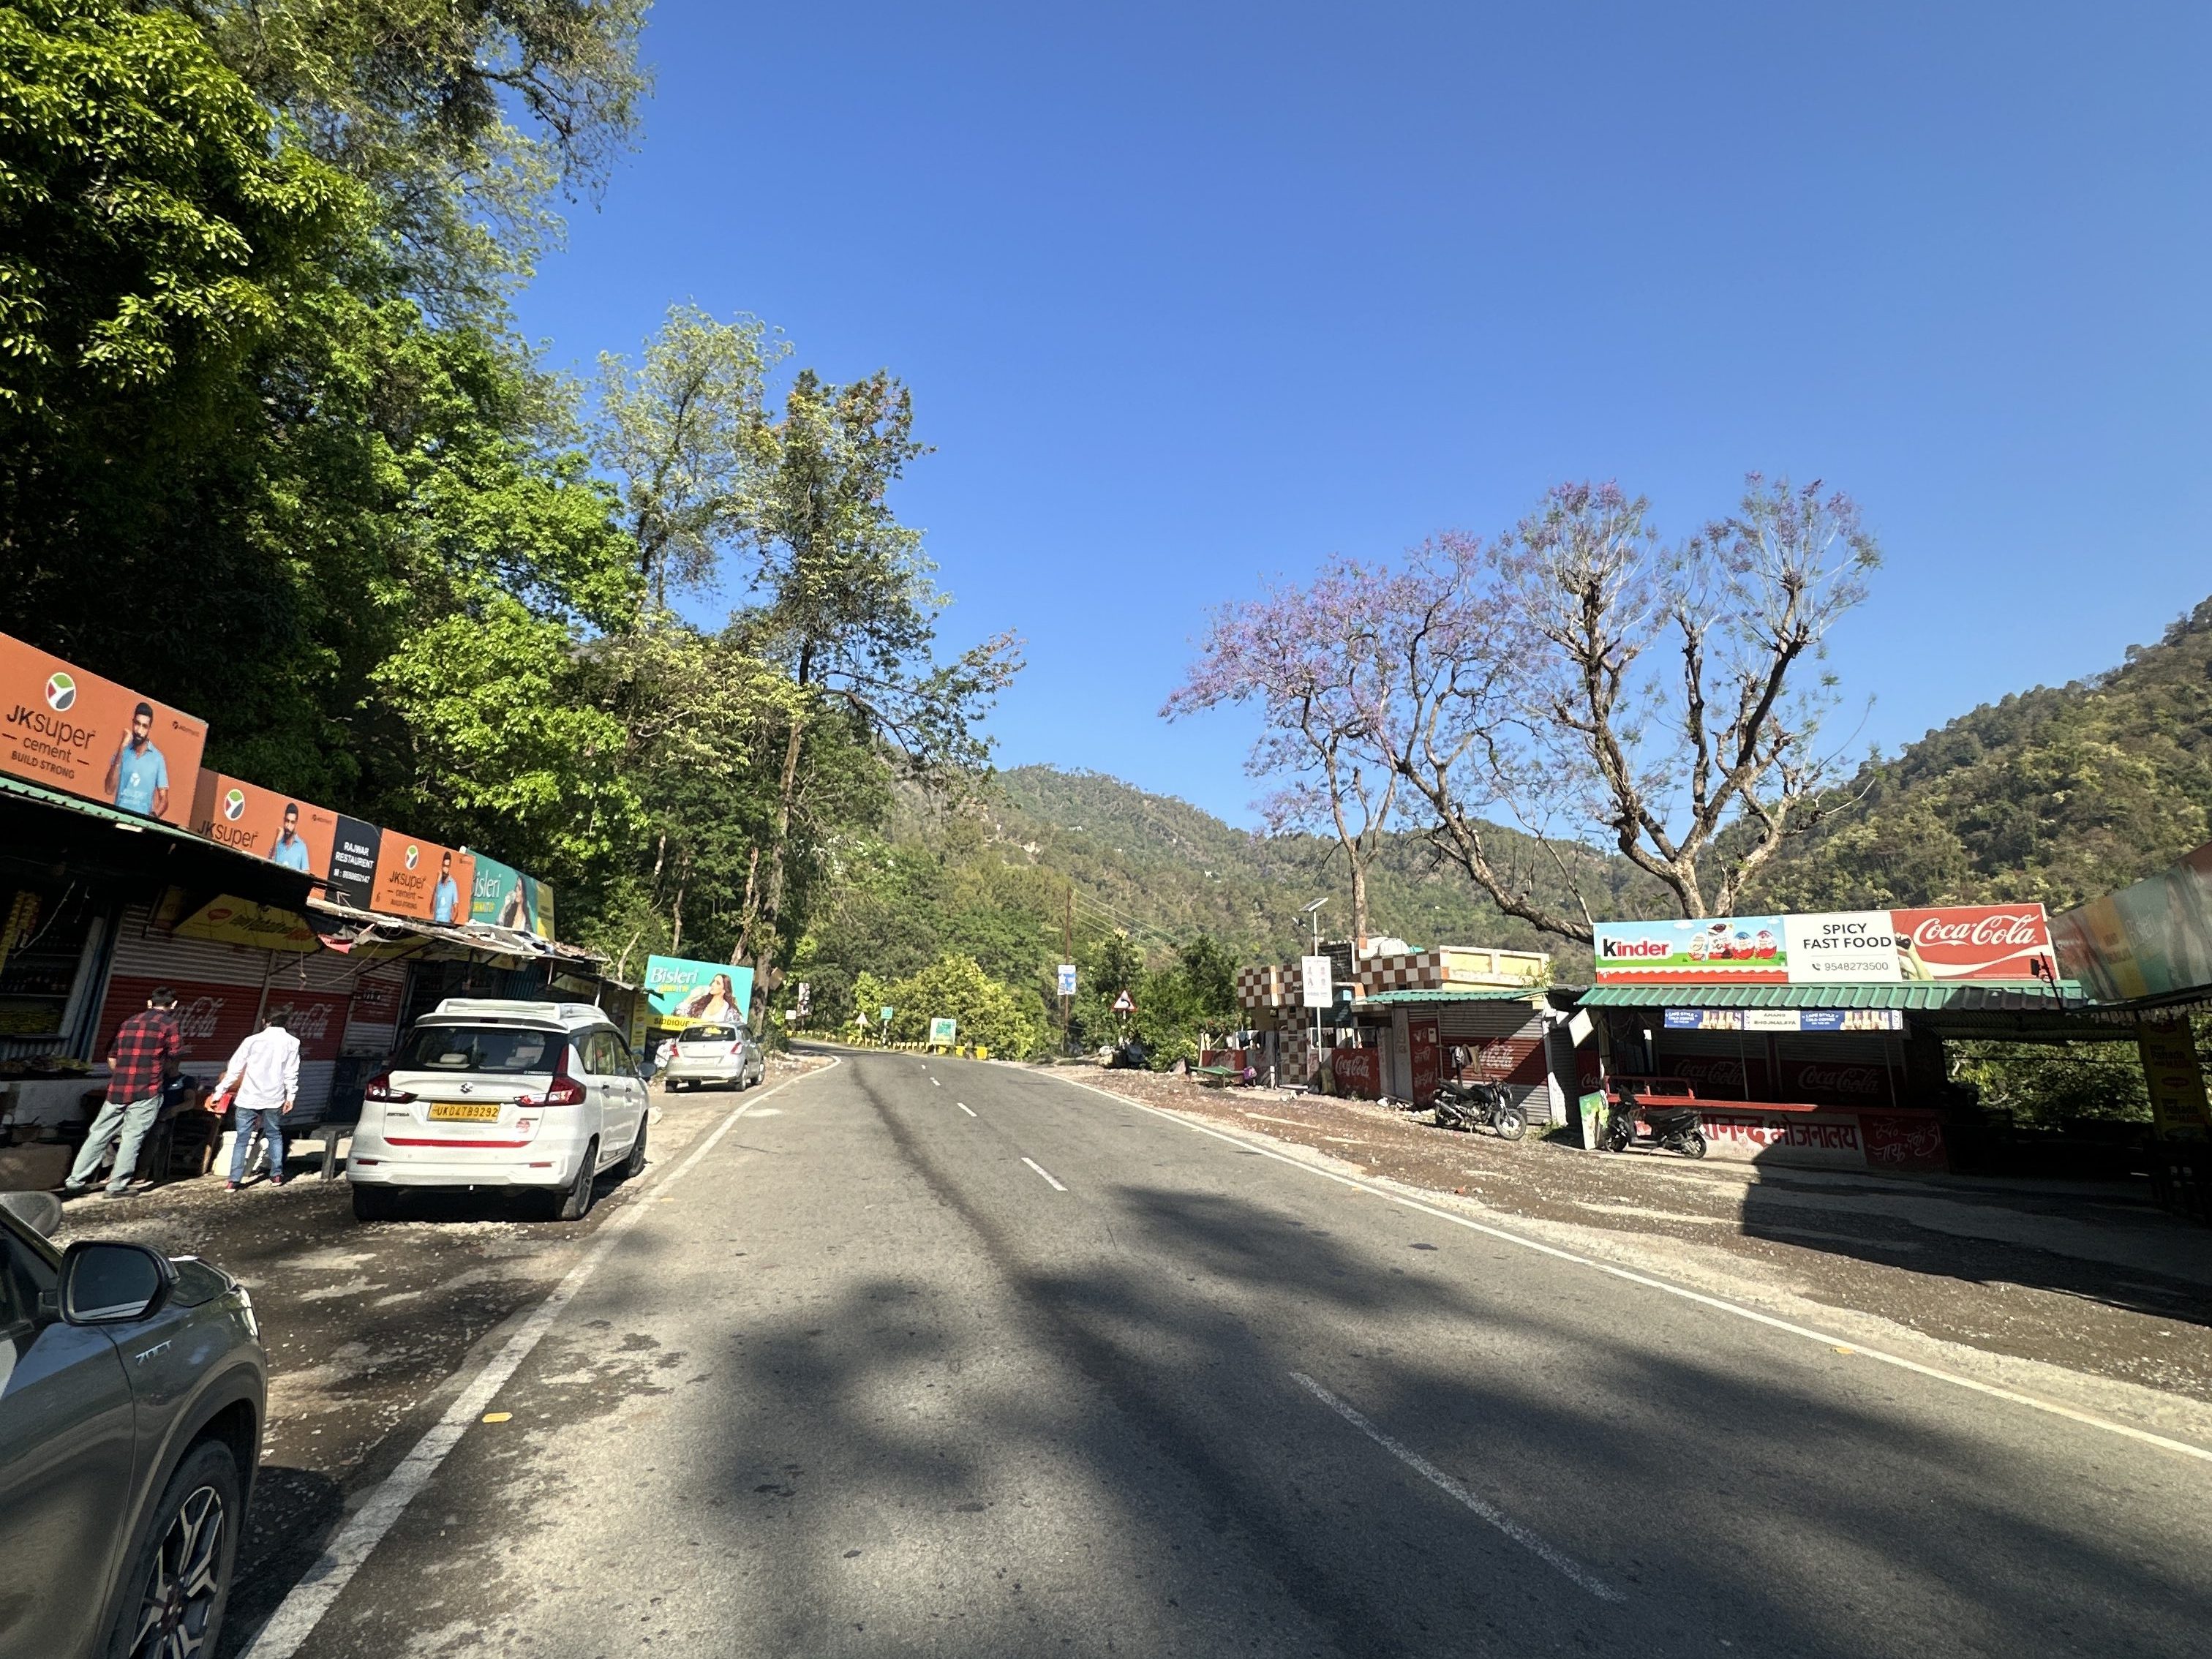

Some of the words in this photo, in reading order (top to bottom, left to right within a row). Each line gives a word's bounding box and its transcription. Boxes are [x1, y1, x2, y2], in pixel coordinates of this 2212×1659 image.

[23, 737, 72, 763] cement
[11, 750, 38, 767] BUILD
[40, 761, 75, 780] STRONG
[344, 841, 369, 857] RAJWAR
[473, 869, 501, 898] isleri
[1822, 923, 1867, 935] SPICY
[1913, 914, 2040, 947] Coca-Cola
[1803, 938, 1840, 949] FAST
[1843, 936, 1892, 948] FOOD
[650, 966, 699, 985] Bisleri
[1824, 962, 1889, 971] 9548273500
